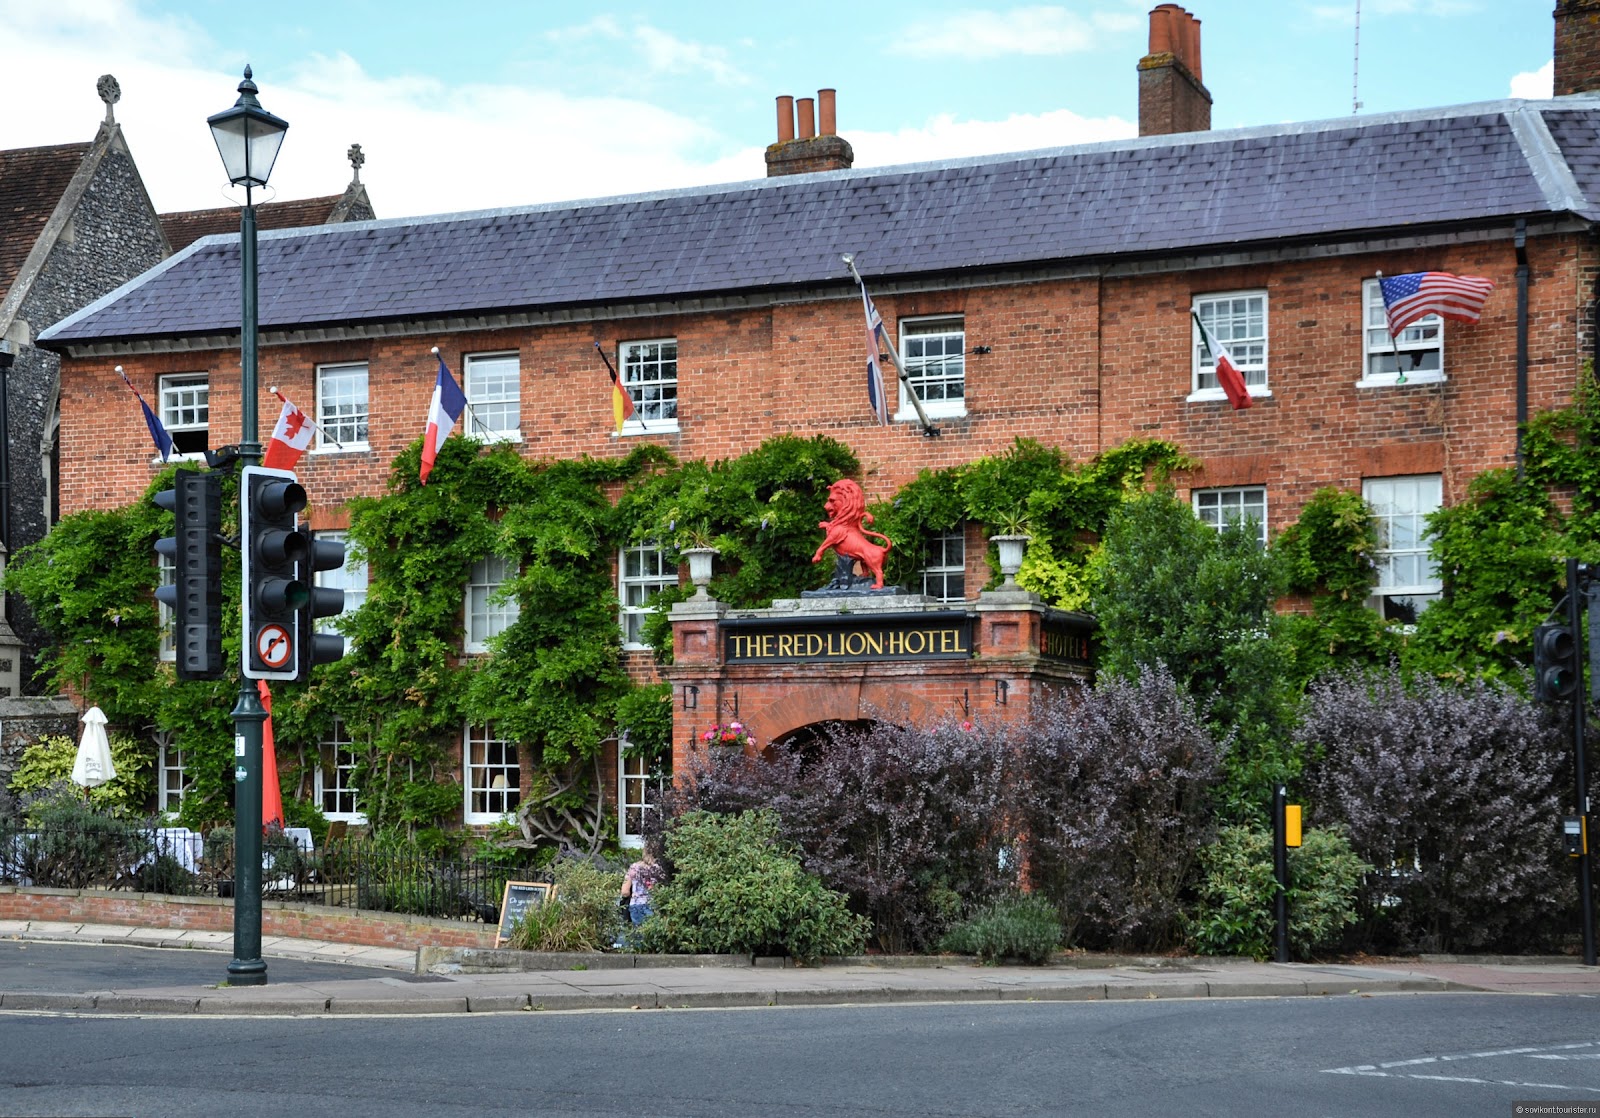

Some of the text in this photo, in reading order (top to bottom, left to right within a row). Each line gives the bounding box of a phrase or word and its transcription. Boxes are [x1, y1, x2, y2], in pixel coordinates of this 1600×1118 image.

[730, 629, 967, 658] THE RED LION HOTEL
[1048, 633, 1080, 659] HOTEL
